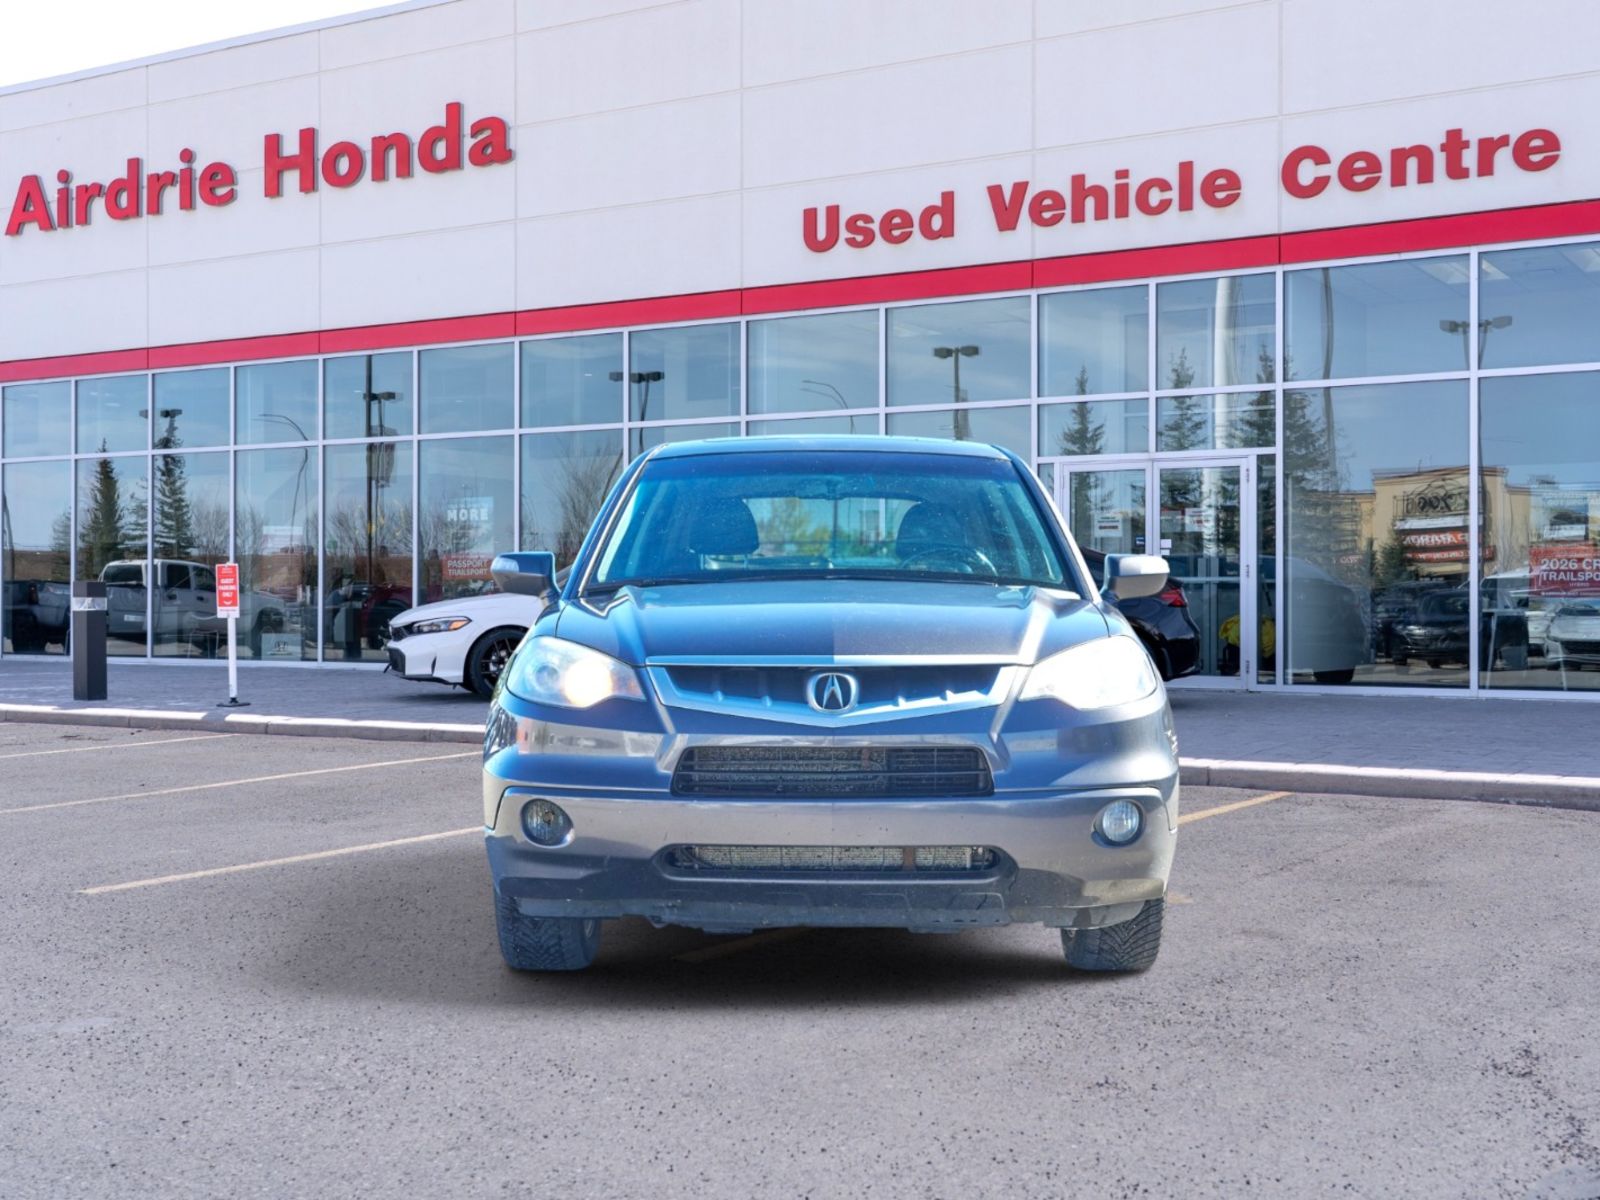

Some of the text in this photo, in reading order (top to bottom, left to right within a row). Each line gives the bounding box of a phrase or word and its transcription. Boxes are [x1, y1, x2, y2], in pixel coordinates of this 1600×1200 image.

[5, 101, 513, 236] Airdrie Honda
[802, 127, 1562, 252] Used Vehicle Centre
[447, 508, 489, 521] MORE
[447, 559, 490, 568] PASSPORT
[1541, 558, 1578, 570] 2026
